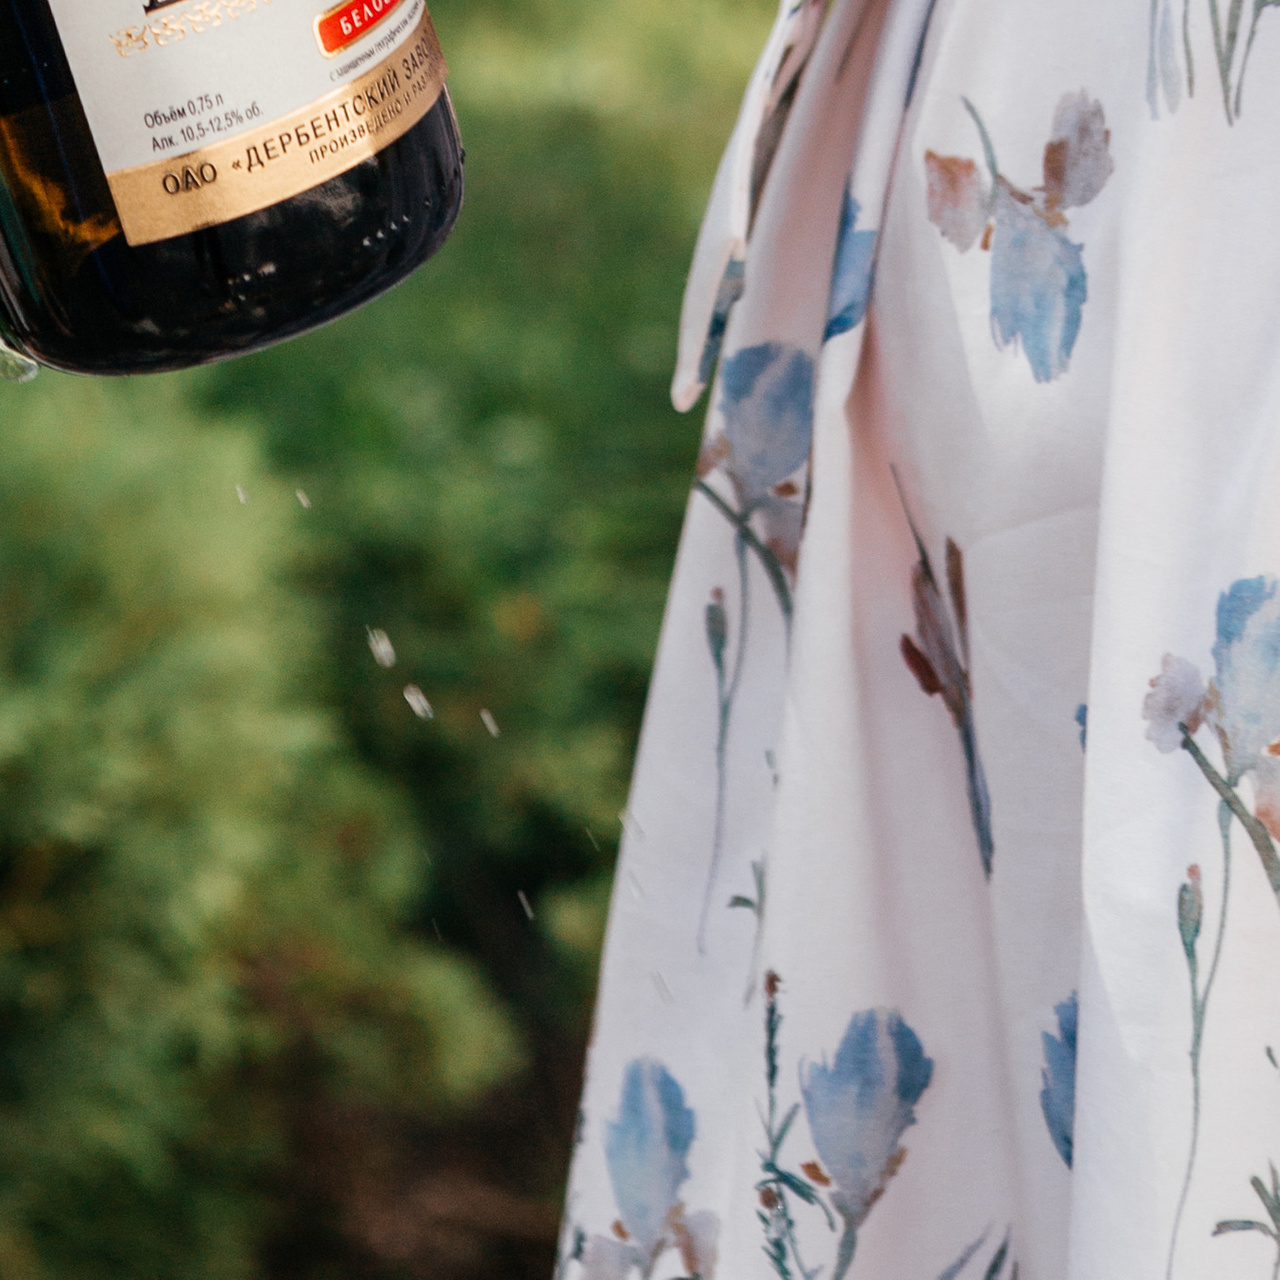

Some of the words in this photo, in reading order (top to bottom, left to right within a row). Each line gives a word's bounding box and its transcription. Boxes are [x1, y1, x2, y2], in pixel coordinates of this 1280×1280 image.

[143, 105, 187, 129] Объём
[187, 93, 214, 116] 0,75
[214, 92, 225, 106] л
[151, 134, 179, 153] Алк.
[180, 109, 244, 143] 10,5-12,5%
[245, 100, 264, 121] об.
[162, 162, 218, 195] ОАО
[231, 67, 402, 174] «ДЕРБЕНТСКИЙ
[308, 99, 402, 164] ПРОИЗВЕДЕНО
[402, 91, 412, 107] И
